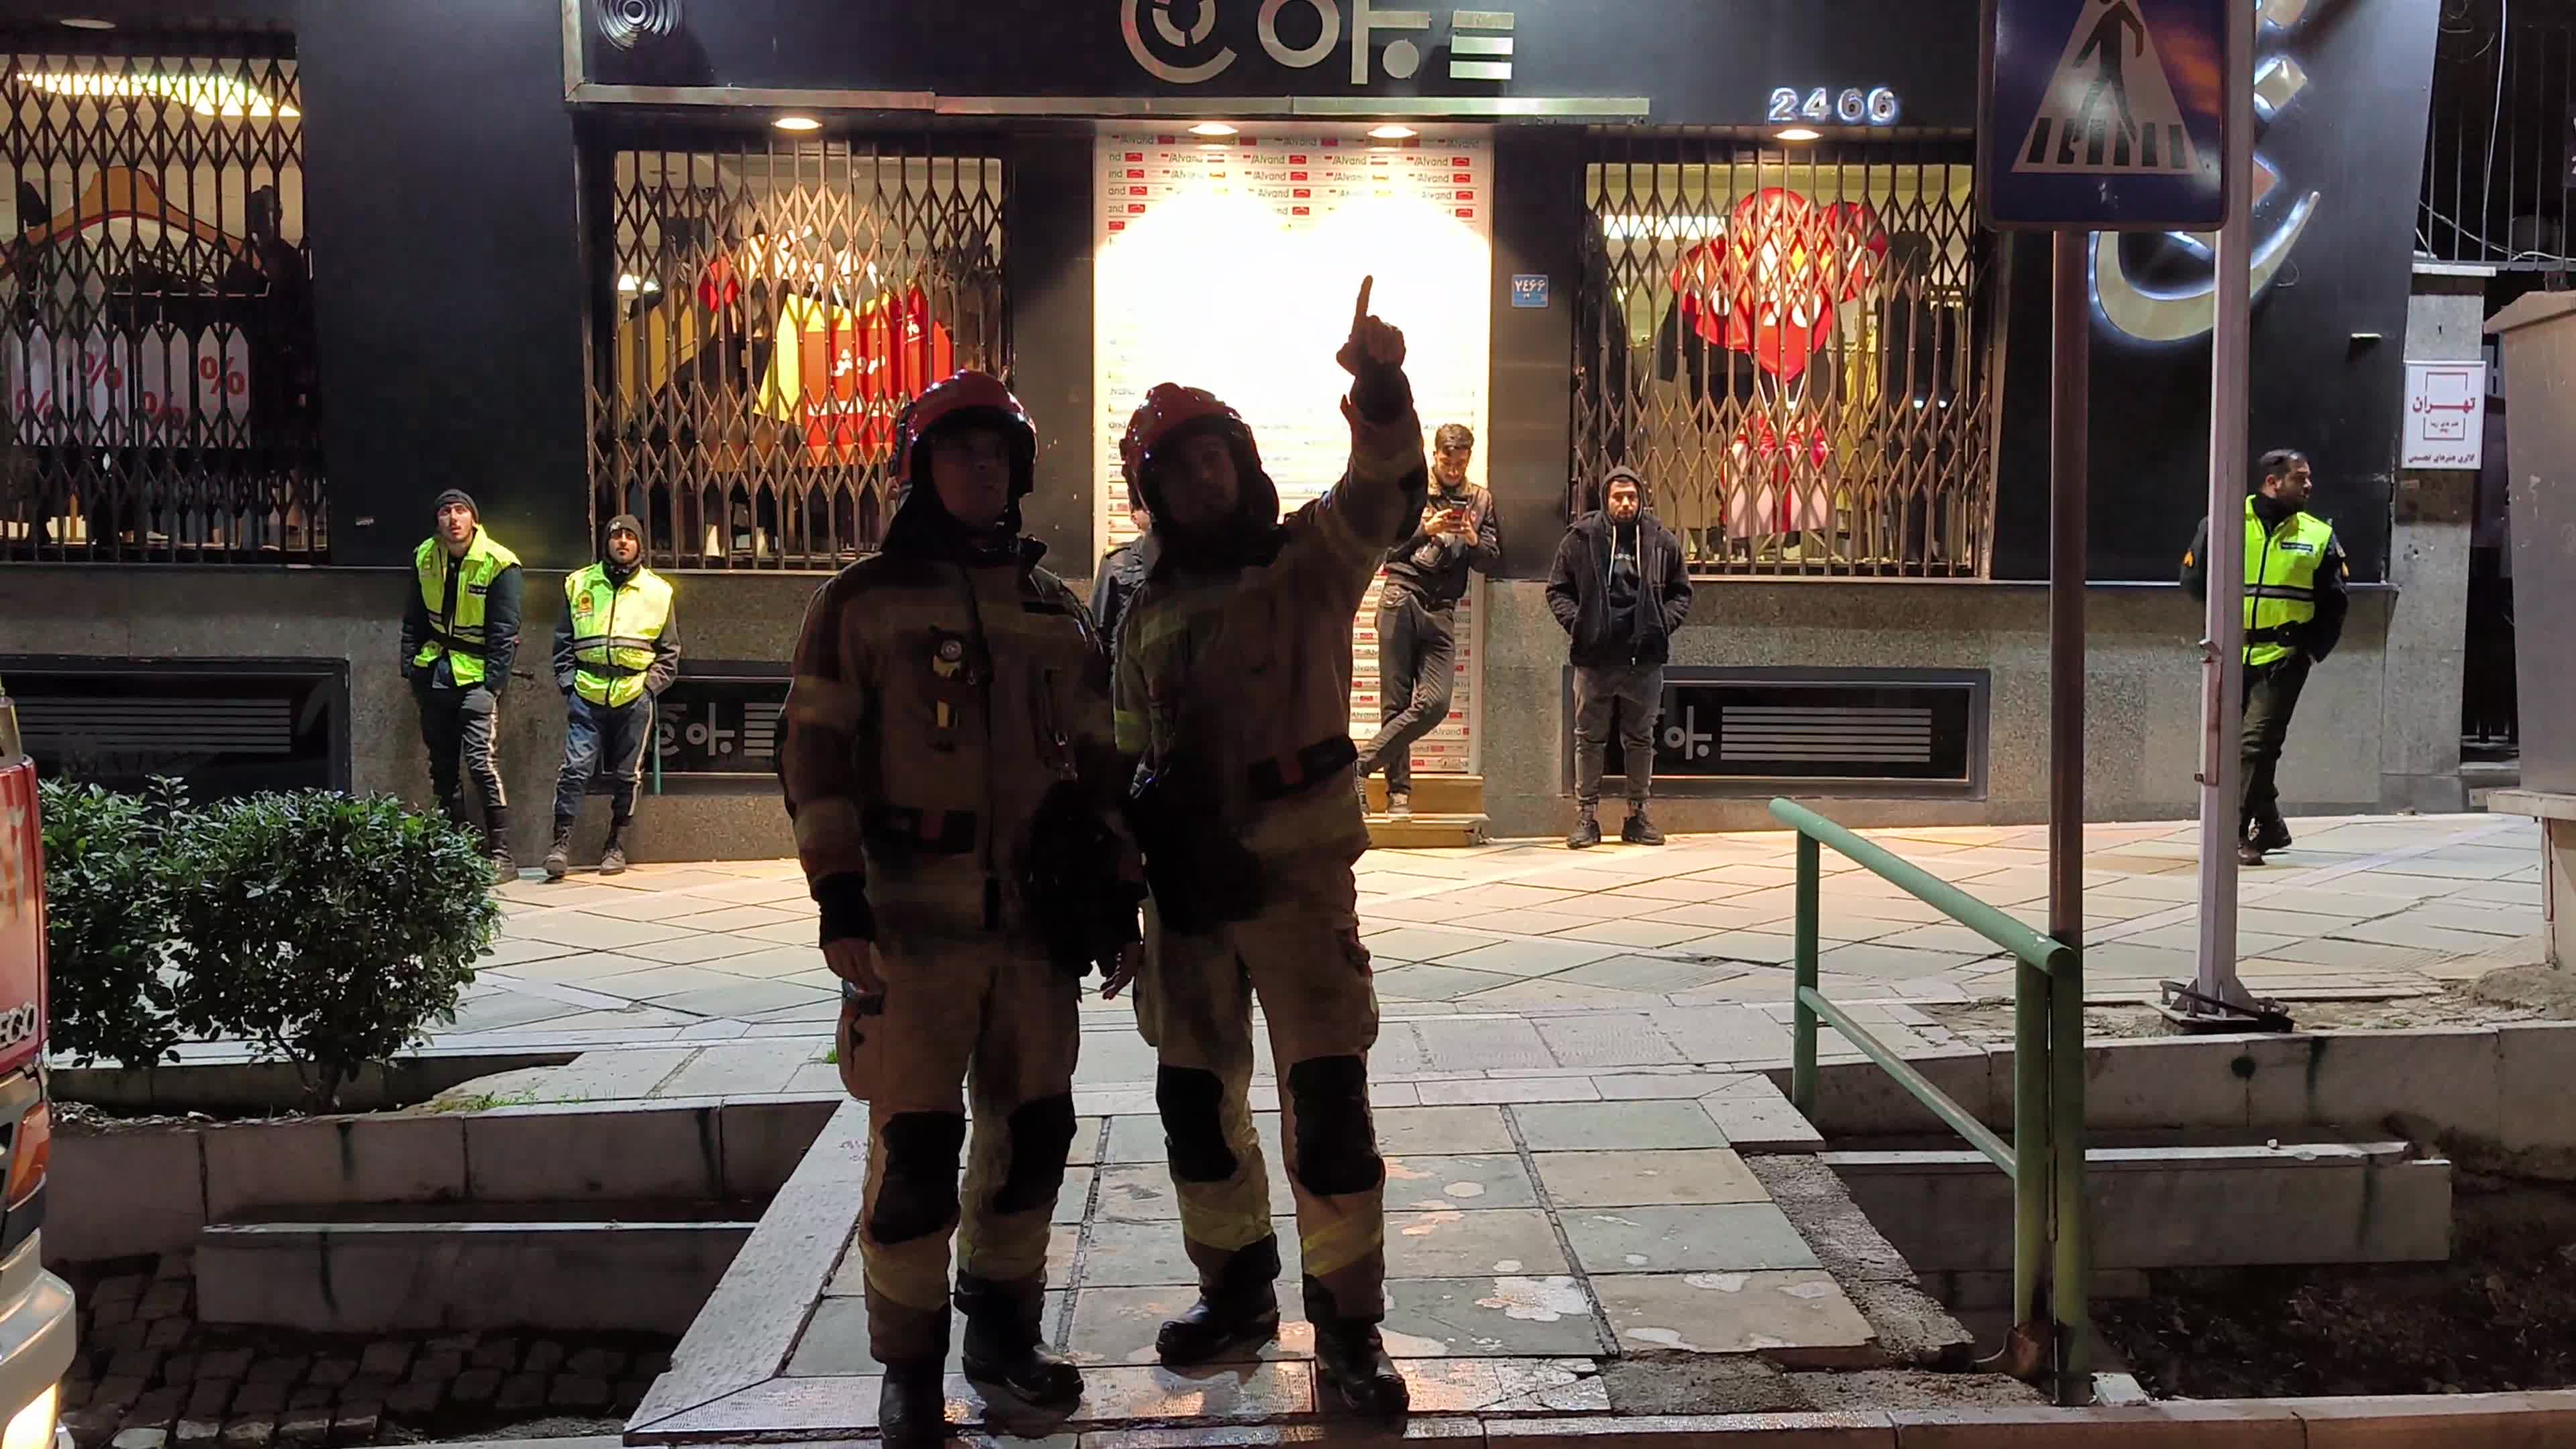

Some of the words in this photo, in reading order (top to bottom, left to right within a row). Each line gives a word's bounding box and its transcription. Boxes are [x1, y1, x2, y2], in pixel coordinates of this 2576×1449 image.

[1768, 87, 1896, 121] 2466
[1251, 155, 1285, 164] Alvand
[1332, 156, 1367, 165] Alvand
[1414, 157, 1449, 166] Alvand
[1253, 172, 1287, 181] Alvand
[2413, 395, 2475, 413] تهران
